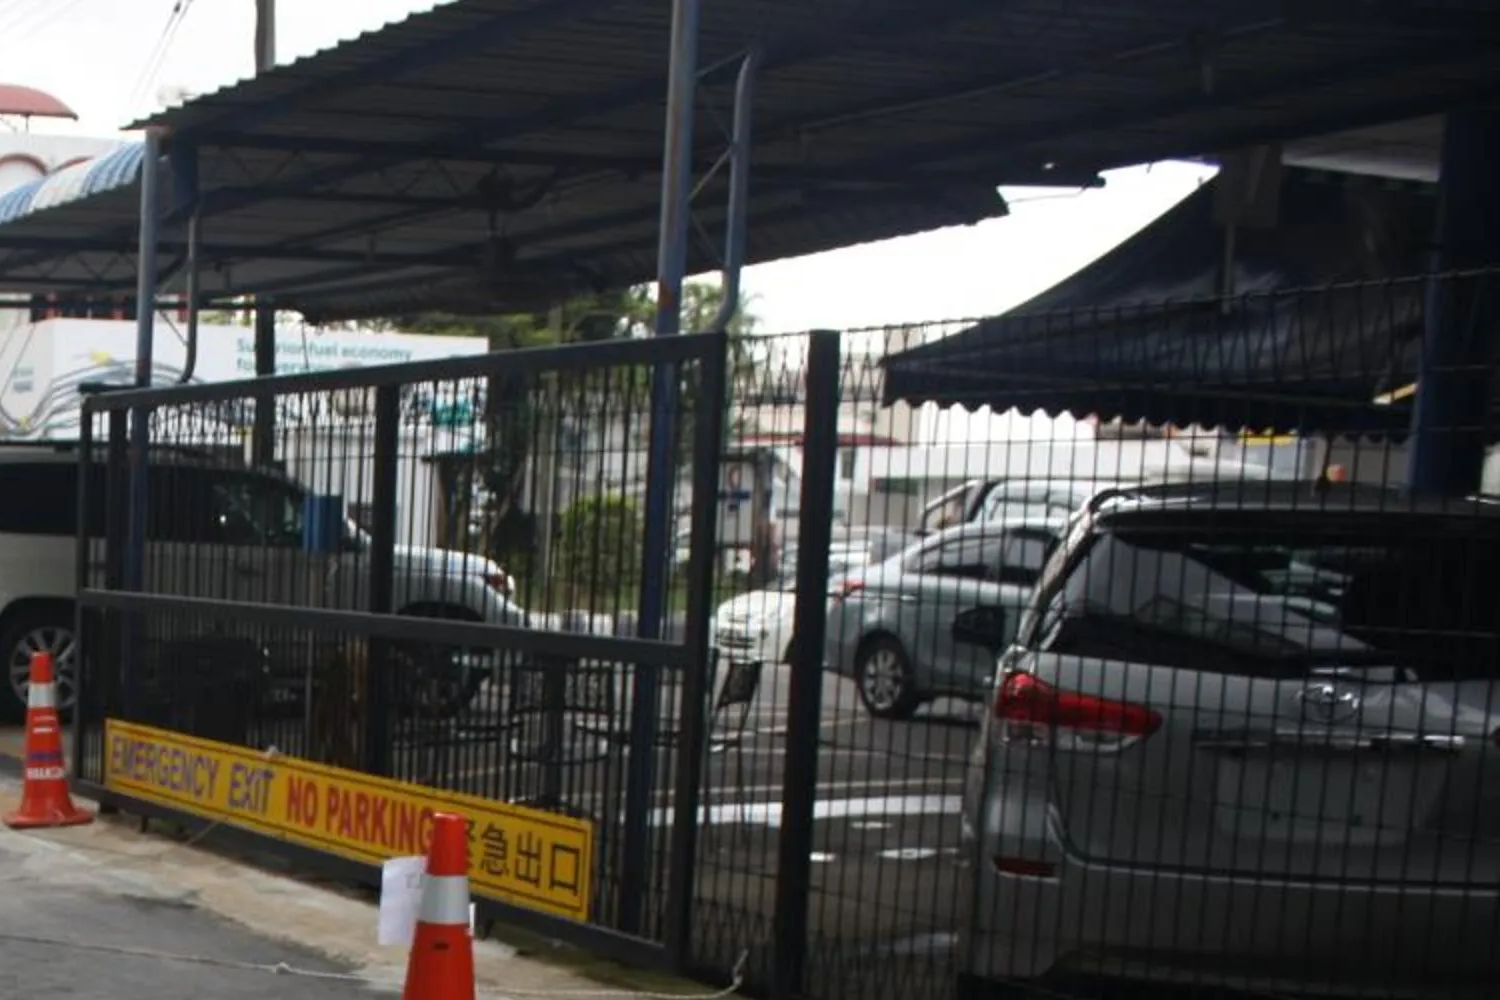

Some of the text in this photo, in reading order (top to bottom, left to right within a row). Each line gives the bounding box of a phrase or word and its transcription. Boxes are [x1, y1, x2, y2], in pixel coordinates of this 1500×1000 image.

[237, 337, 303, 353] Surior
[342, 344, 412, 361] economy
[110, 735, 437, 856] EMERGENCY EXIT NO PARKING
